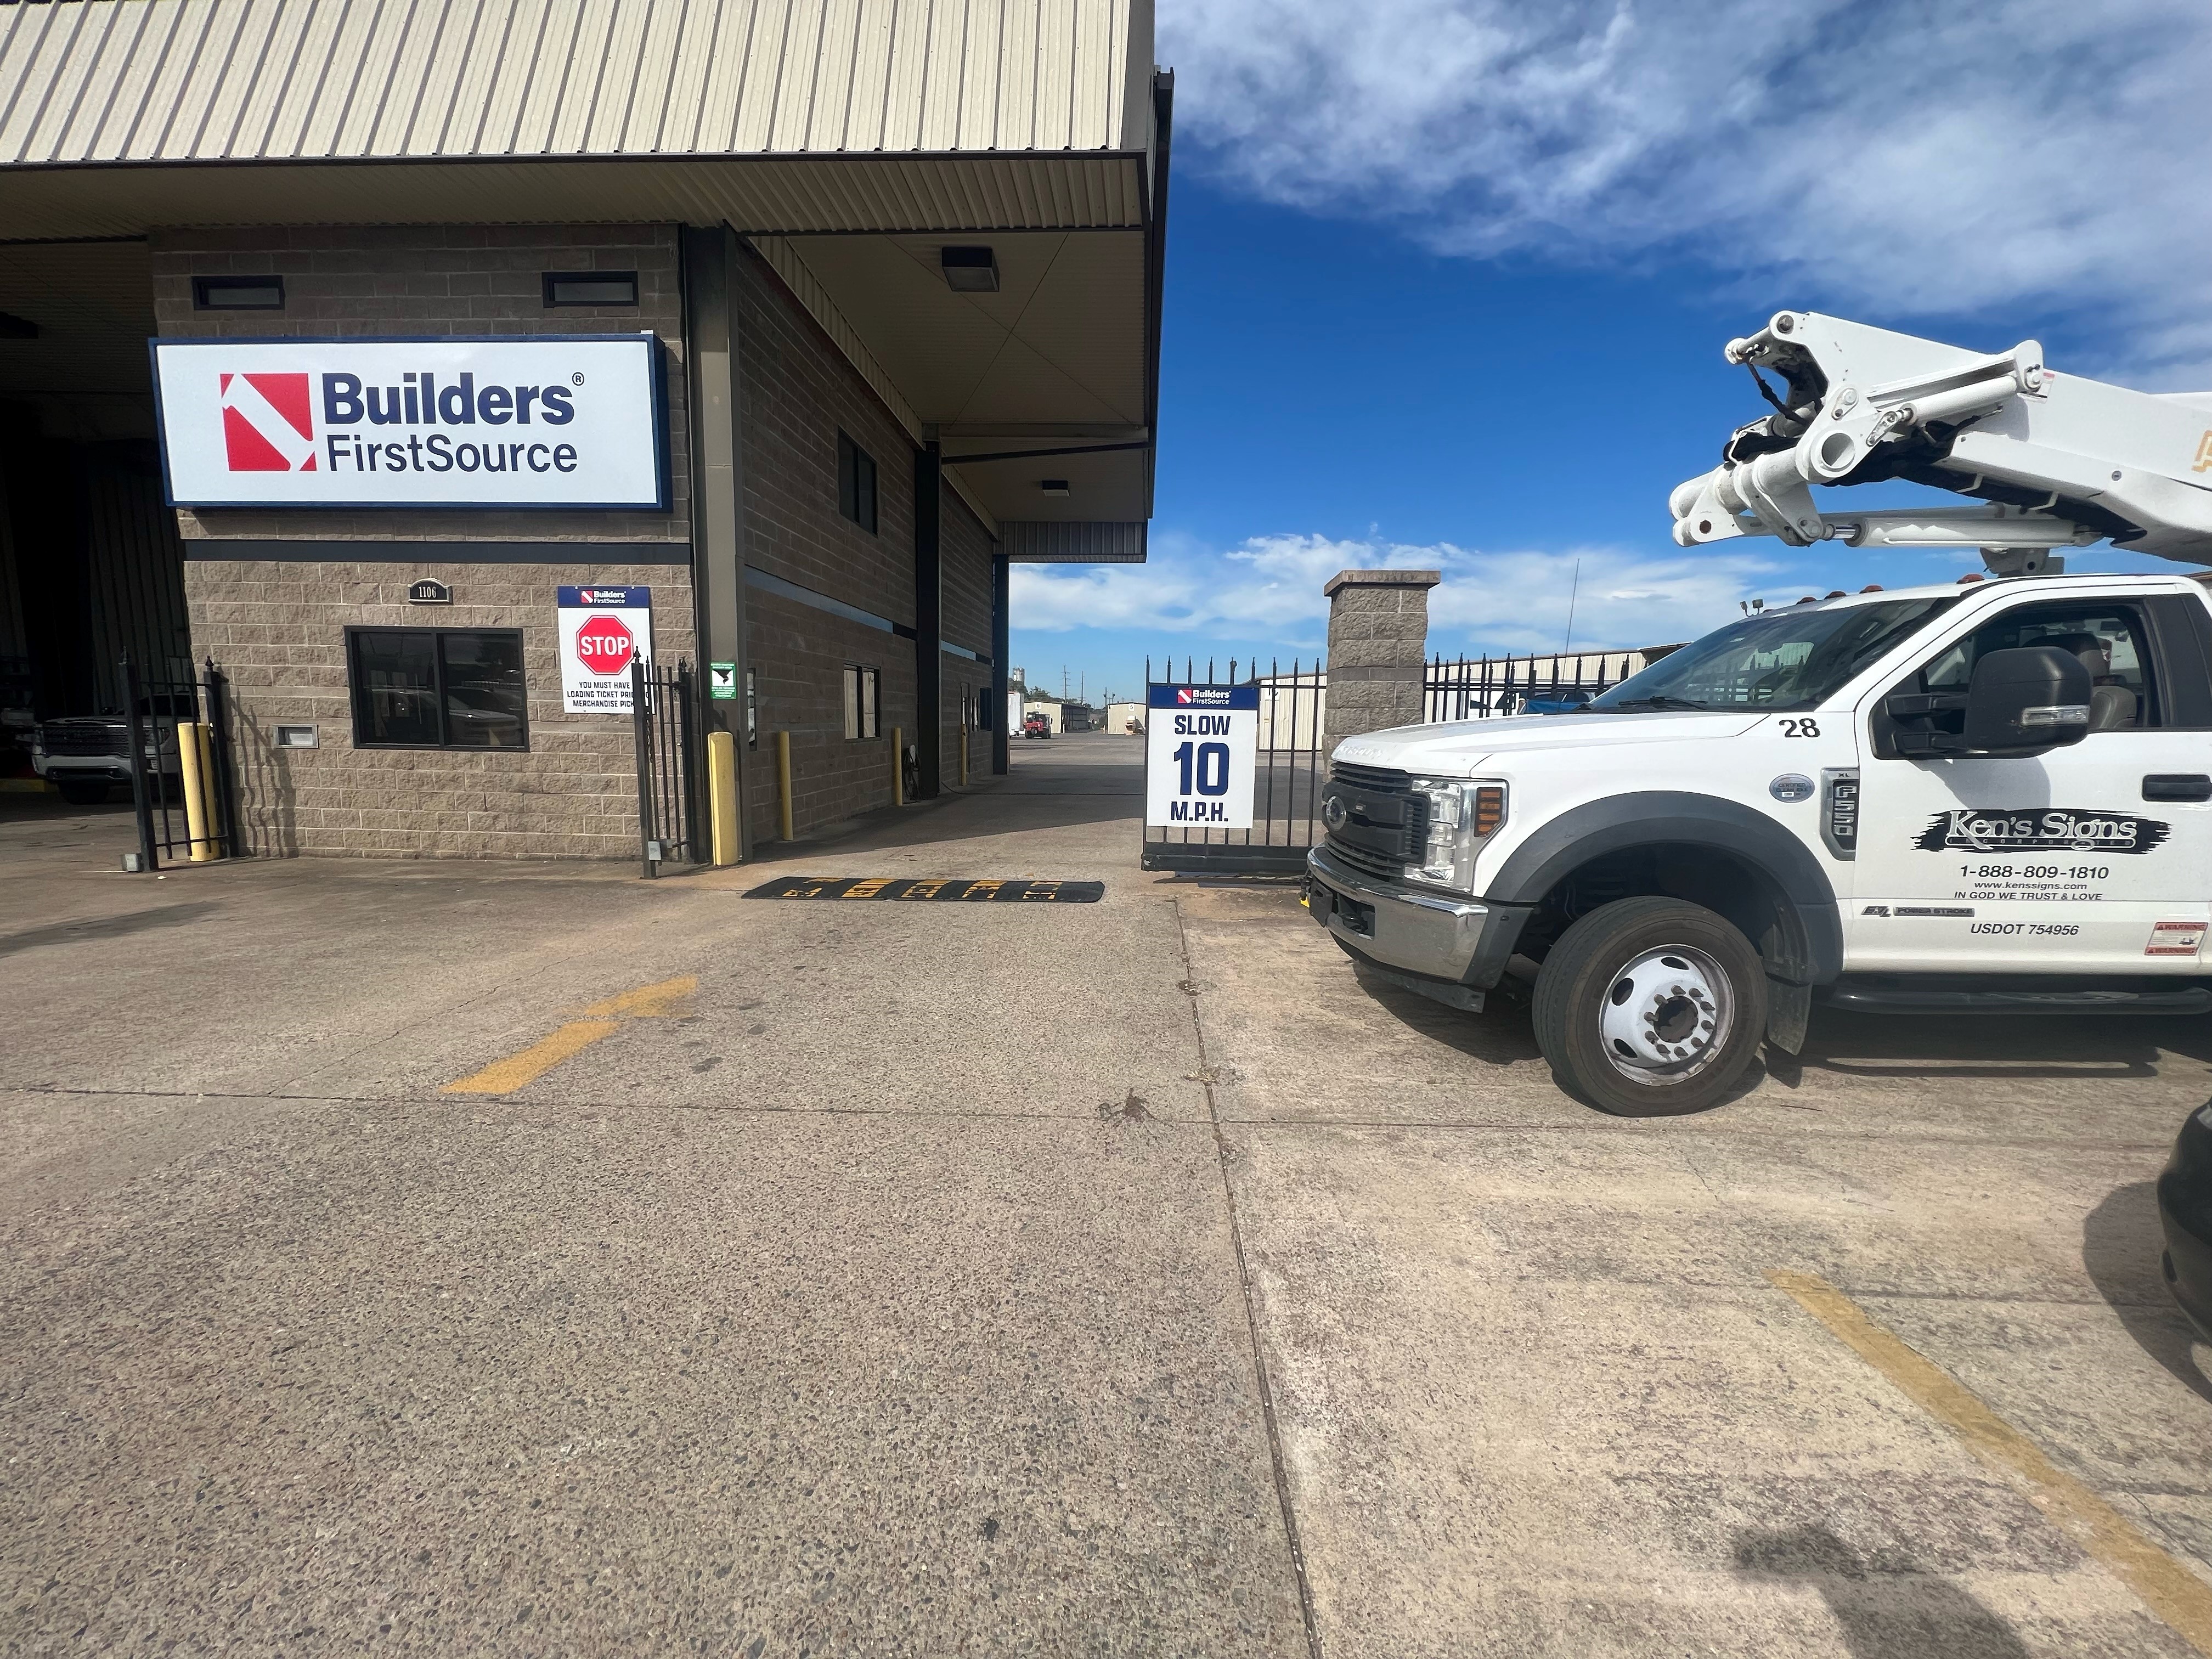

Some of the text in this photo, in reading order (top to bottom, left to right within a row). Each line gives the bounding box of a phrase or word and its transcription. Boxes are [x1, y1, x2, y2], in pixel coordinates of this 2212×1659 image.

[326, 433, 578, 473] FirstSource
[419, 586, 437, 598] 1106
[580, 635, 629, 656] STOP
[1175, 715, 1231, 736] SLOW
[1779, 718, 1821, 738] 28
[1173, 741, 1229, 796] 10
[1171, 801, 1229, 822] M.P.H.
[1946, 811, 2137, 851] Ken's Signs
[1960, 865, 2109, 879] 1-888-809-1810
[1974, 881, 2087, 890] www.kenssigns.com
[1970, 923, 2080, 935] USDOT 754956
